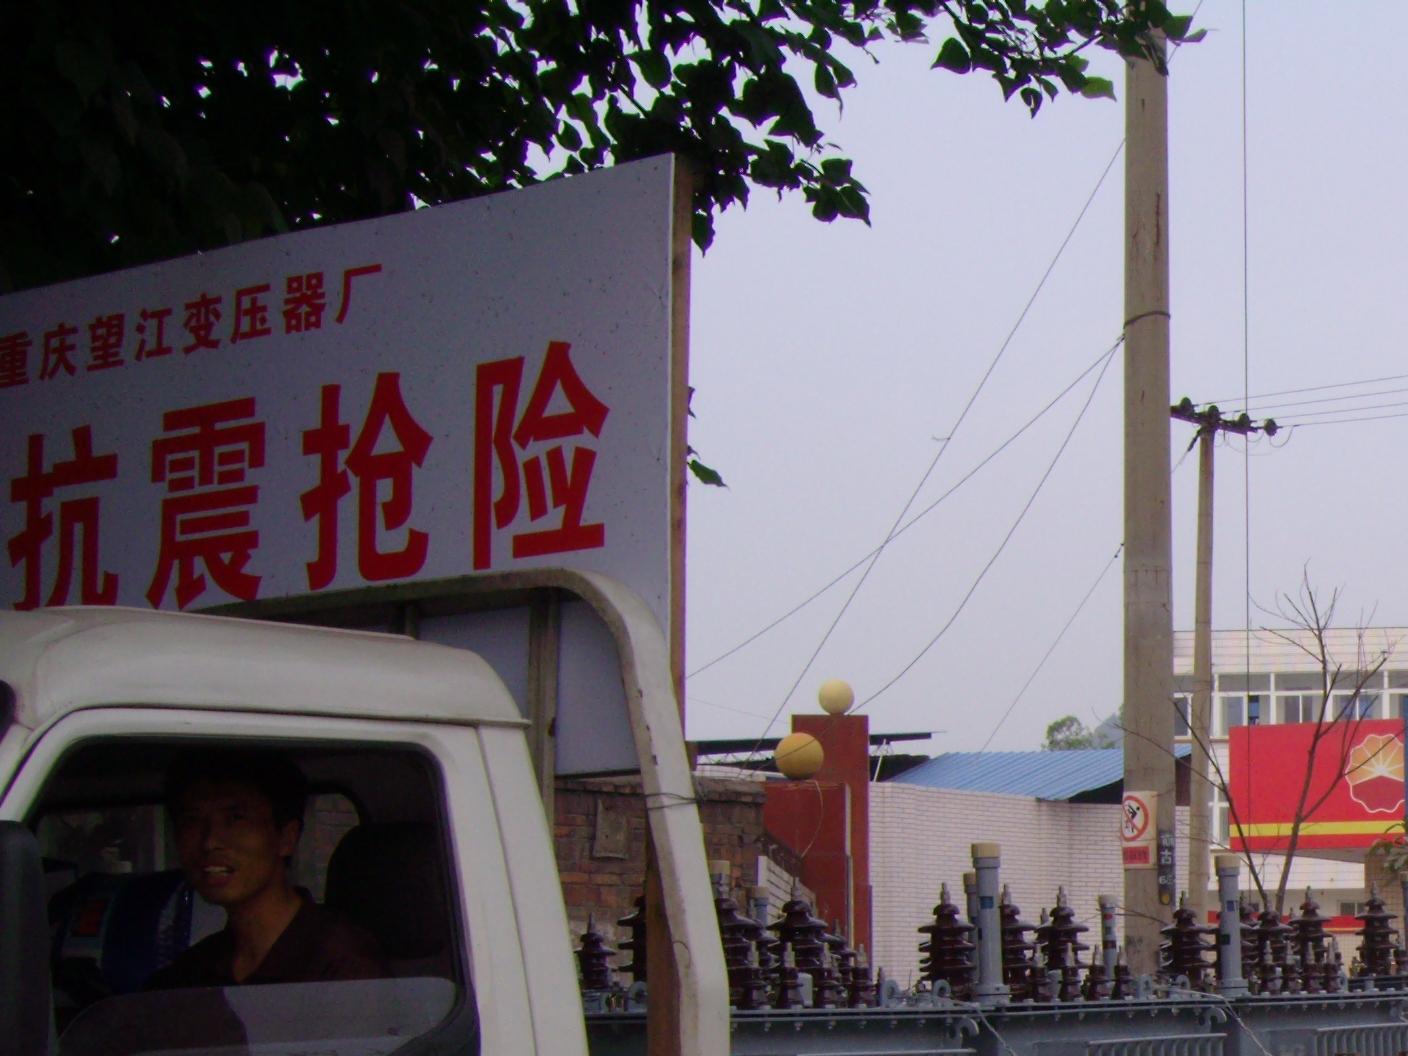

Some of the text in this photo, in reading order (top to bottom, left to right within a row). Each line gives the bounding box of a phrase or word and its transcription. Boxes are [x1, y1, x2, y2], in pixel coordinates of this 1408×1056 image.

[0, 263, 383, 389] 重庆望江变压器厂
[7, 340, 610, 613] 抗震抢险
